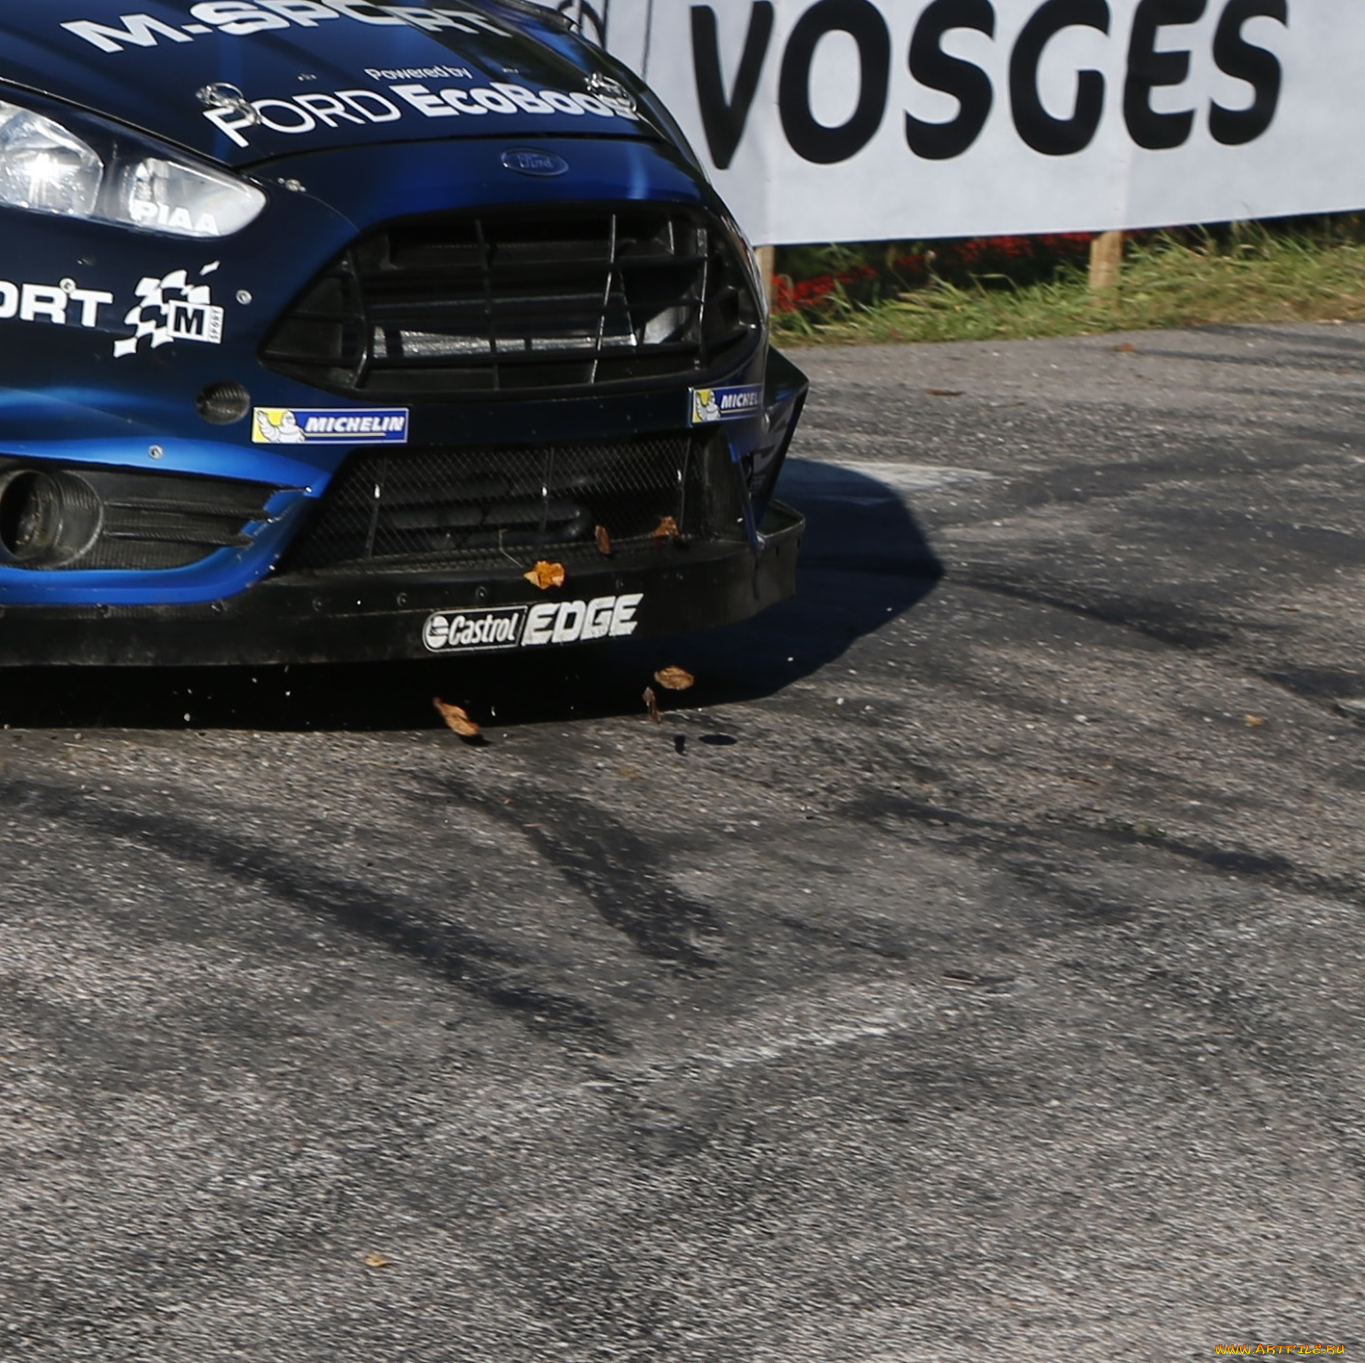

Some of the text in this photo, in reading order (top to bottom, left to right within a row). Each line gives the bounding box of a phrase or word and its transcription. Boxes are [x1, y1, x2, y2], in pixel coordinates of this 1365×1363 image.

[363, 64, 473, 82] Powered by
[203, 89, 402, 149] FORD
[132, 199, 220, 236] PIAA
[173, 305, 205, 336] M
[304, 416, 405, 433] MICHELIN
[448, 593, 644, 647] Castrol EDGE
